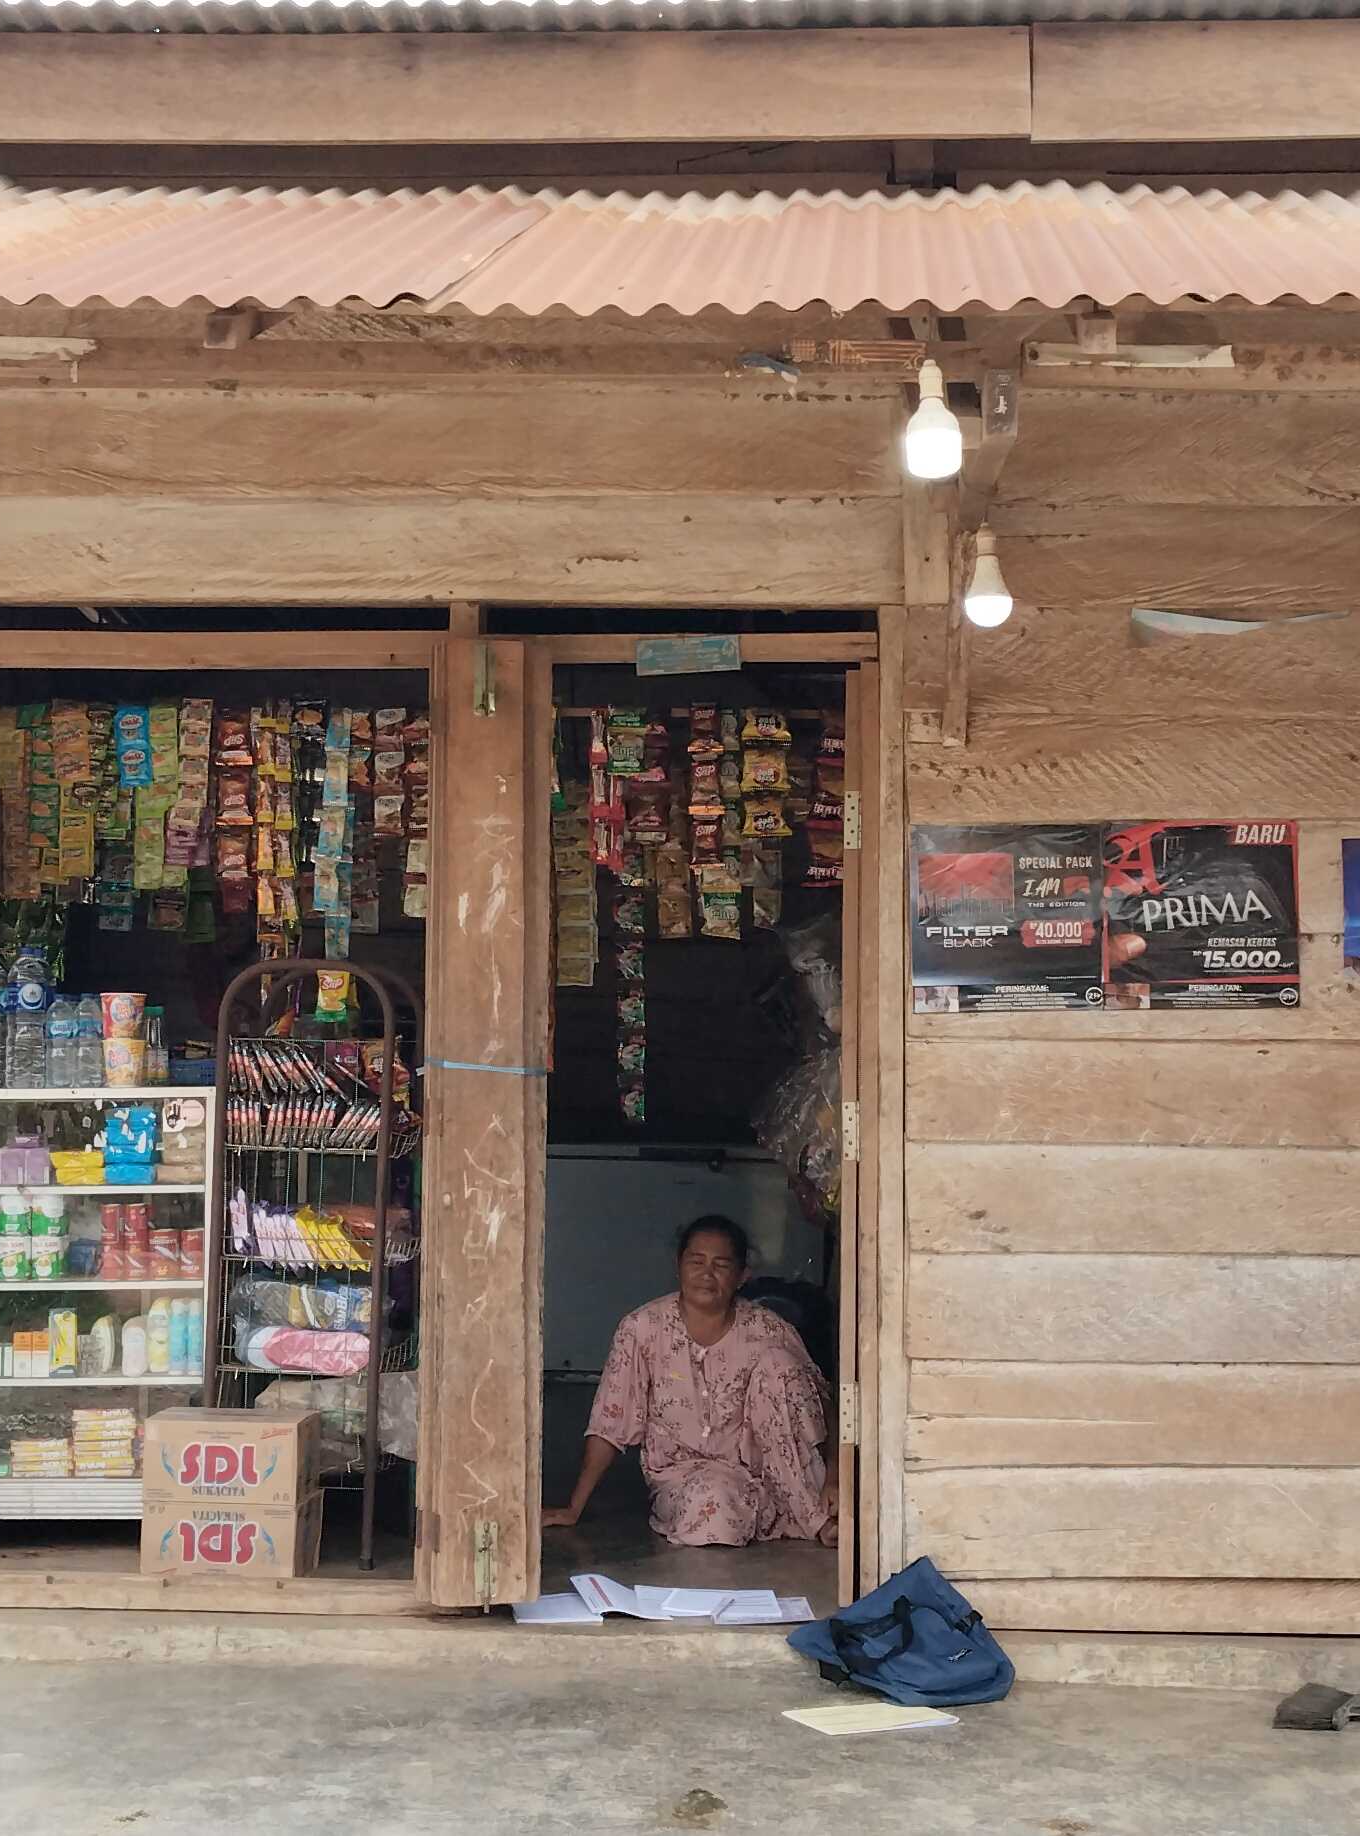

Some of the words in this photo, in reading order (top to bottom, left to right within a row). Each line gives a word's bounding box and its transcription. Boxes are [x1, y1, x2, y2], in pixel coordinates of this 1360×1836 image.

[1233, 824, 1287, 844] BARU
[1018, 856, 1063, 870] SPECIAL
[1065, 855, 1093, 868] PACK
[1035, 877, 1061, 898] AM
[1141, 889, 1273, 932] PRIMA
[926, 925, 1009, 937] FILTER
[1035, 921, 1082, 938] 40.000
[943, 938, 993, 948] BLACK
[1202, 950, 1281, 968] 15.000
[179, 1442, 260, 1487] SDL
[178, 1519, 259, 1565] SDL
